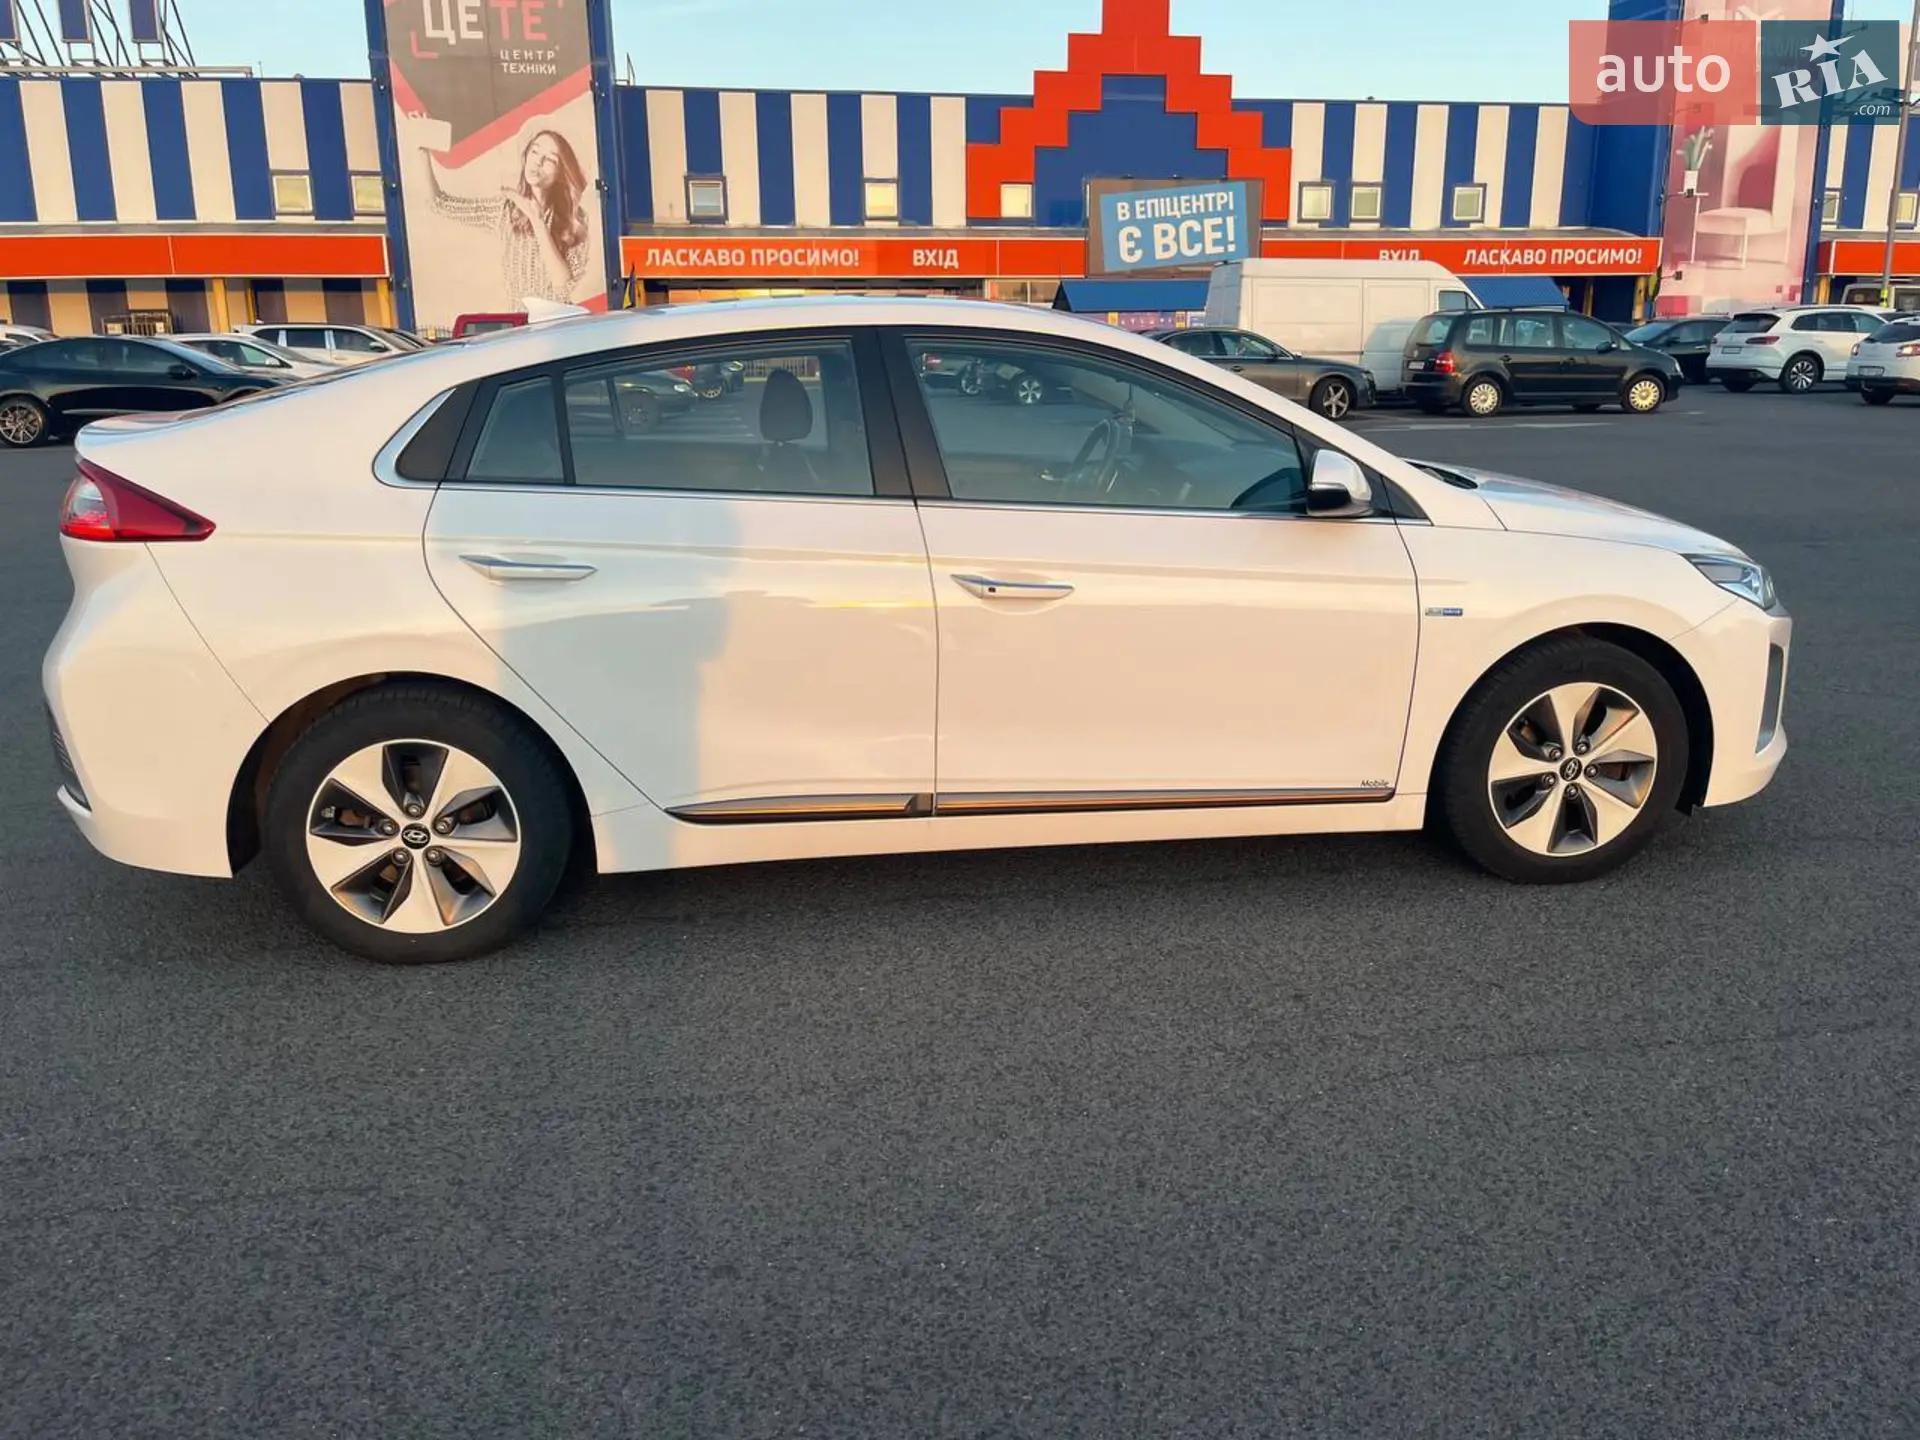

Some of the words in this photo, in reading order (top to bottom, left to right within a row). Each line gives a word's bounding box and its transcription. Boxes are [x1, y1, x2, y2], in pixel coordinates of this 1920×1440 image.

[500, 49, 556, 61] ЦЕНТР
[501, 62, 557, 75] ТЕХНІКИ
[1116, 201, 1131, 222] В
[1135, 191, 1234, 220] ЕПІЦЕНТРІ
[1118, 226, 1143, 263] Є
[1153, 215, 1237, 260] ВСЕ!
[645, 248, 745, 268] ЛАСКАВО
[751, 249, 859, 267] ПРОСИМО!
[912, 249, 959, 269] ВХІД
[1463, 248, 1546, 265] ЛАСКАВО
[1550, 248, 1643, 265] ПРОСИМО!
